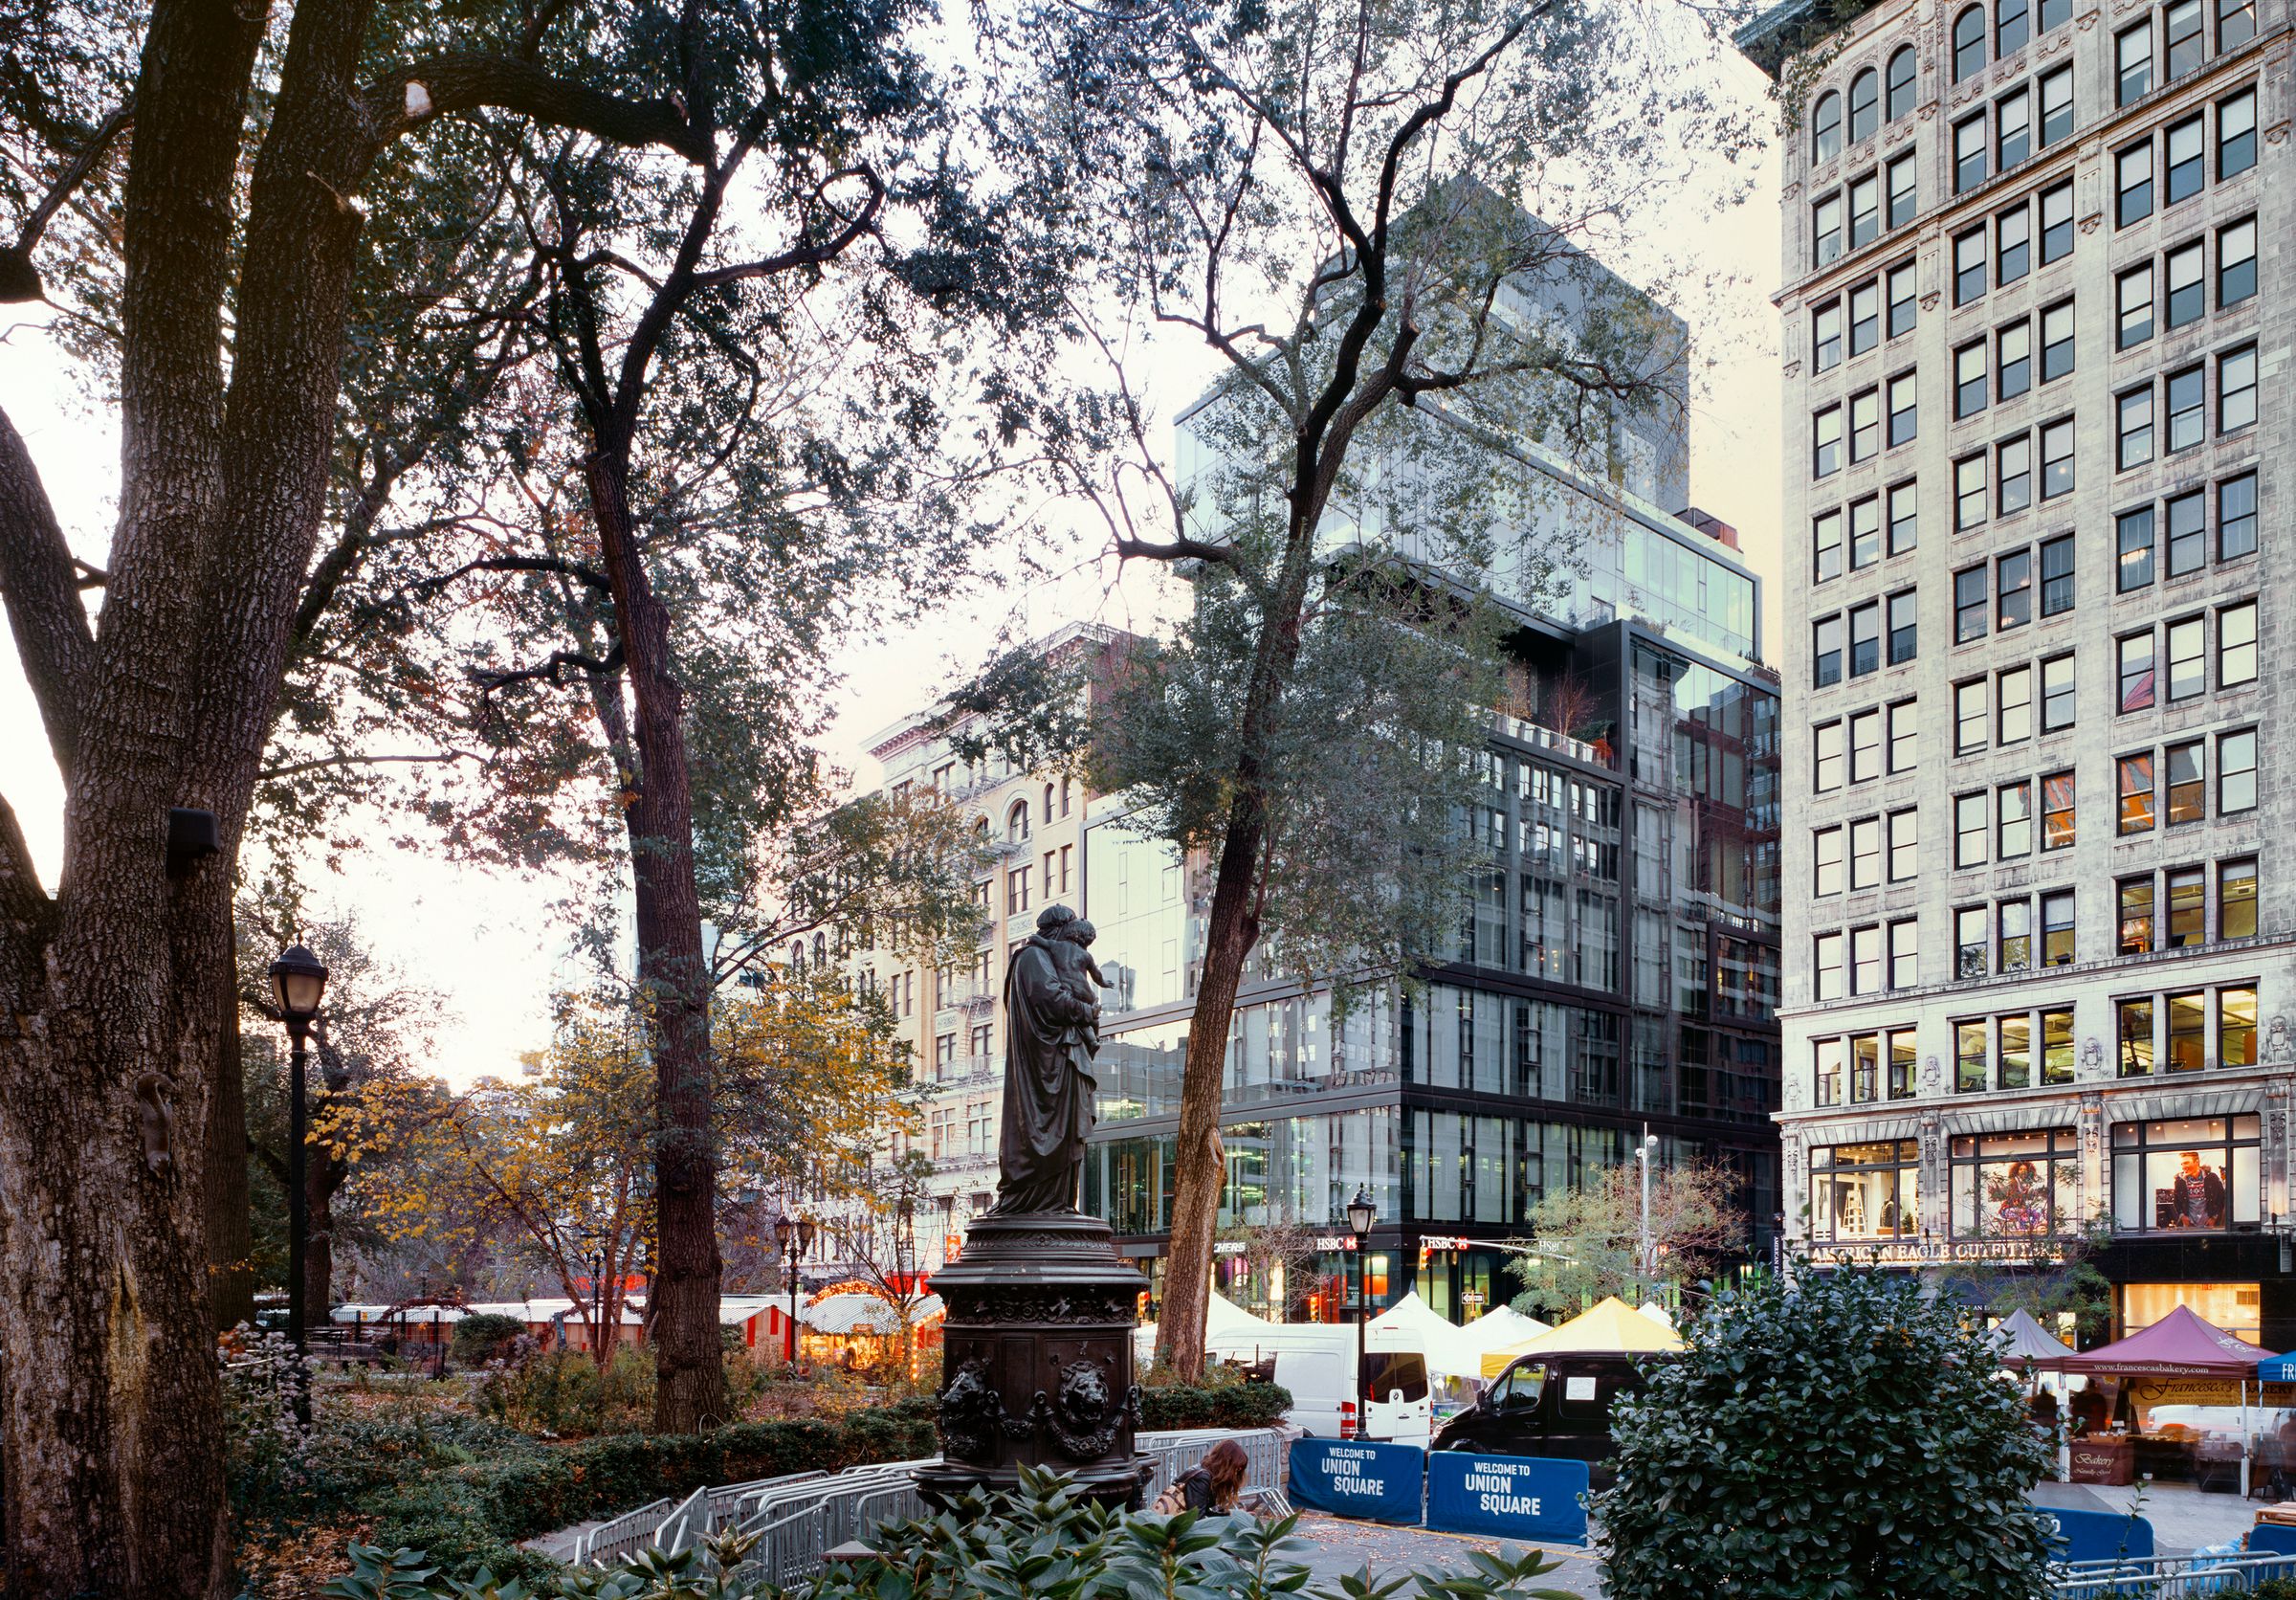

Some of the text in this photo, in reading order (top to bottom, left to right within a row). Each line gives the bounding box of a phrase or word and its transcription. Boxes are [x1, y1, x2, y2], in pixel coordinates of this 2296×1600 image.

[1316, 1237, 1343, 1251] HSBC
[1427, 1236, 1455, 1250] HSBC
[1812, 1242, 2063, 1259] AMRICN EAGLE OUTFITTS
[2094, 1363, 2209, 1375] www.francescasbakery.com
[2282, 1363, 2296, 1380] FR
[1329, 1447, 1376, 1460] WELCOME TO
[2074, 1453, 2114, 1469] Bakery
[1321, 1457, 1360, 1477] UNION
[1474, 1461, 1531, 1477] WELCOME TO
[1334, 1476, 1384, 1497] SQUARE
[1465, 1473, 1512, 1494] UNION
[1480, 1493, 1541, 1516] SQUARE
